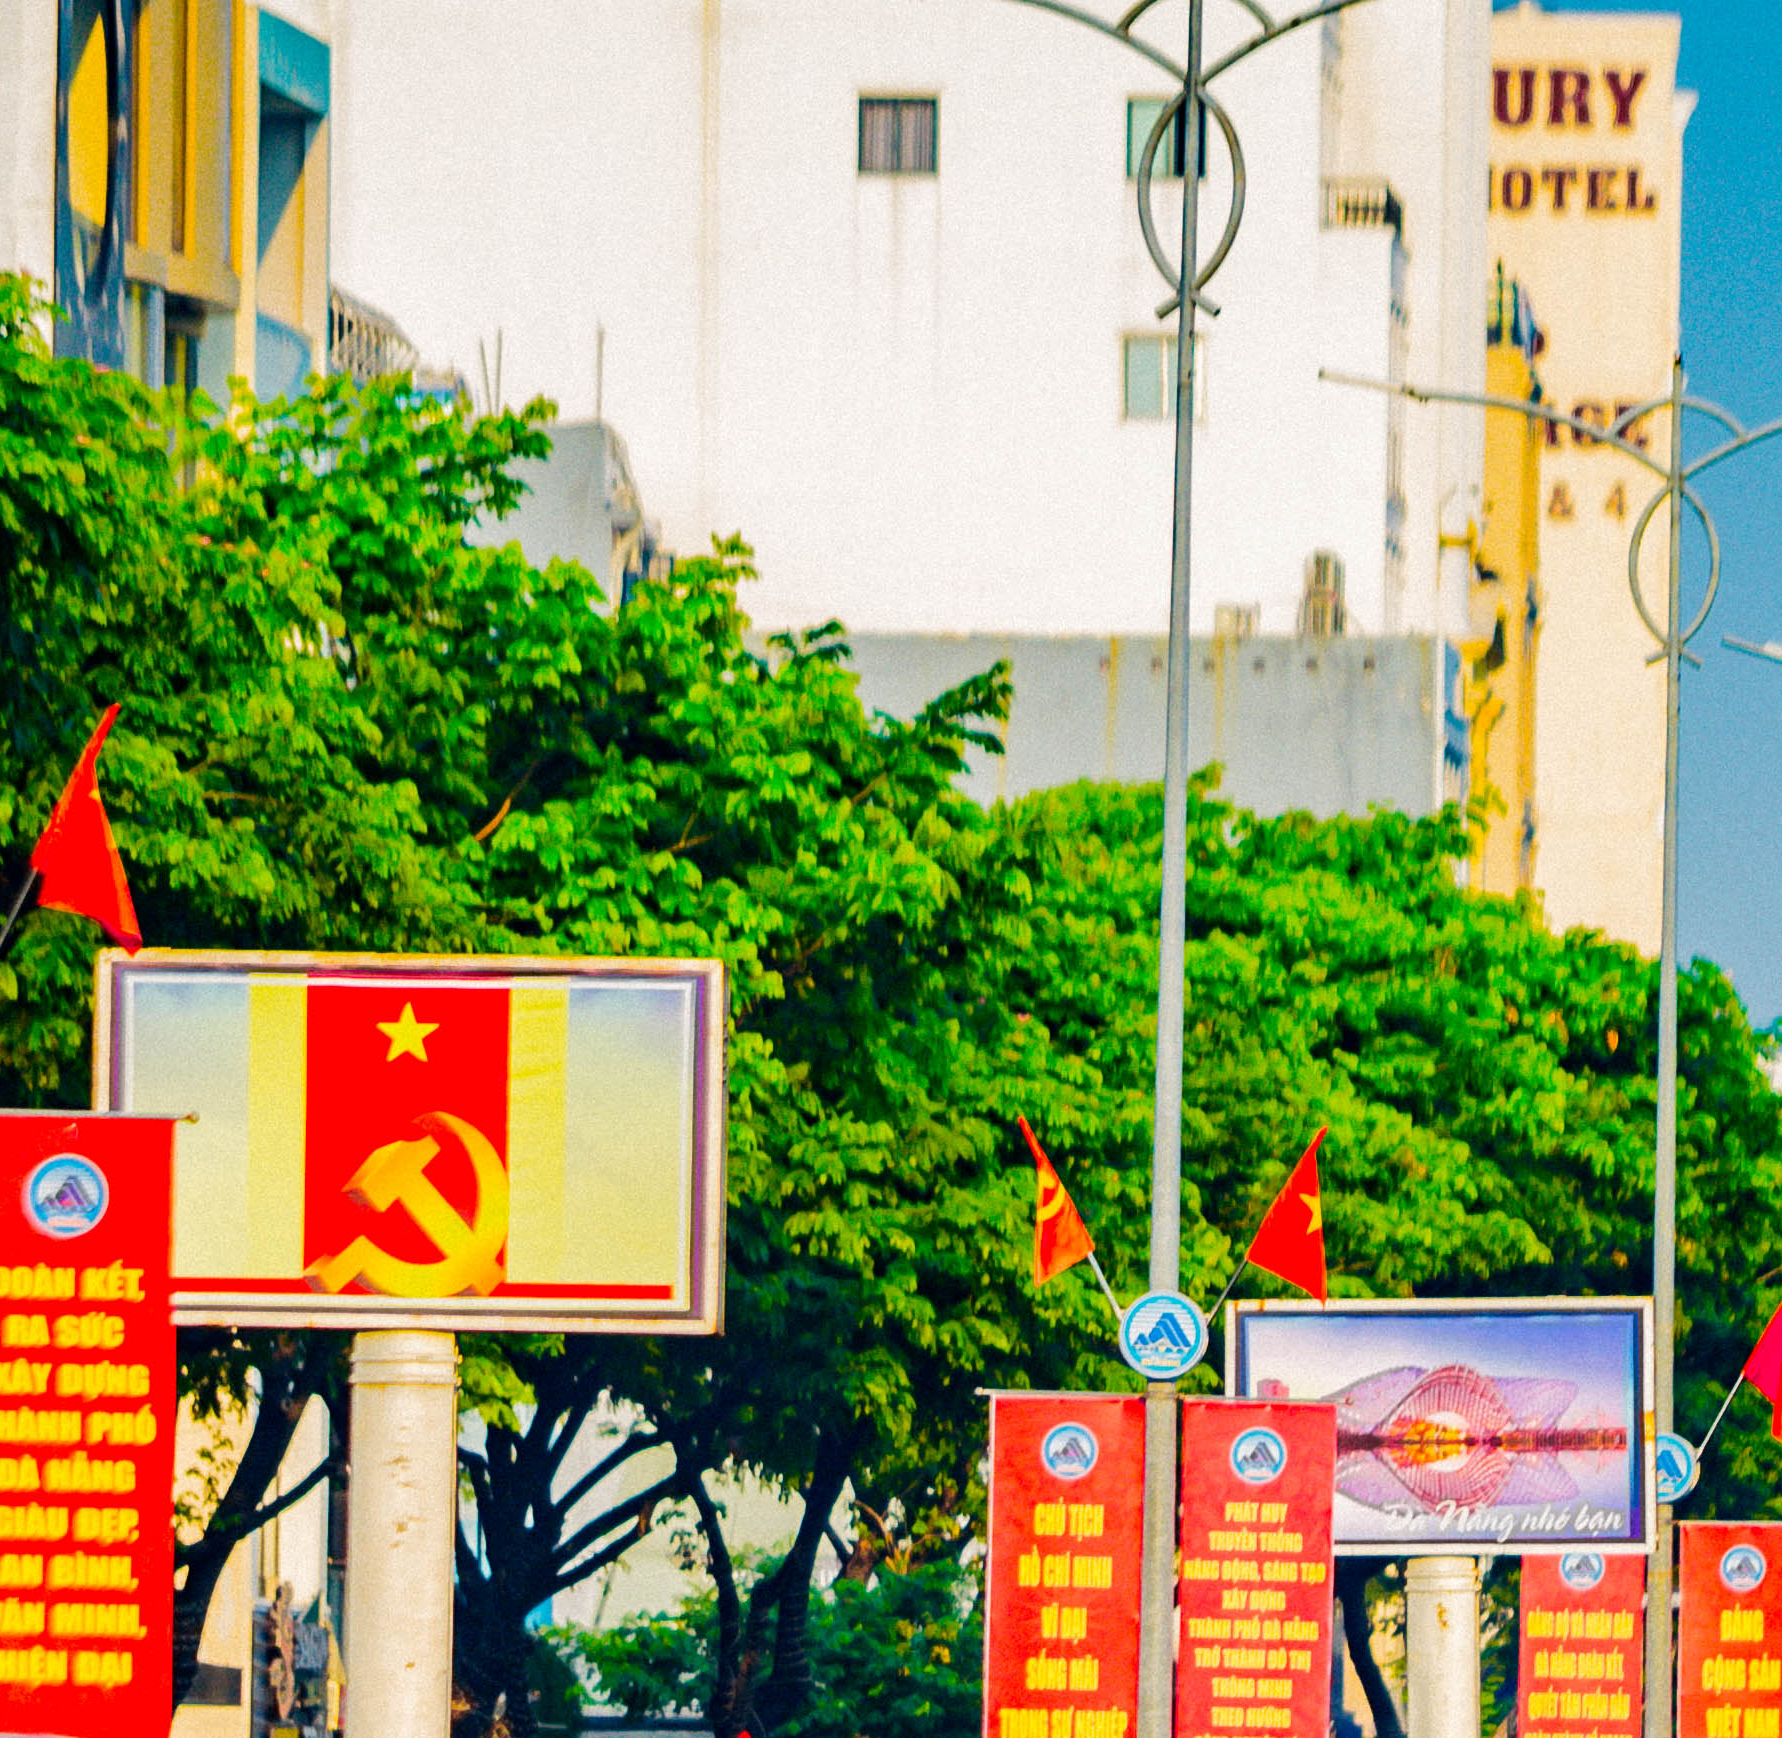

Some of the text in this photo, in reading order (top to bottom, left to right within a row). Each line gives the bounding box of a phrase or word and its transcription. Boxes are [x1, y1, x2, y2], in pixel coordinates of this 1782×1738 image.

[81, 1261, 146, 1301] KẾT,
[2, 1308, 125, 1349] RA SỨC
[56, 1363, 150, 1402] DỰNG
[87, 1408, 157, 1445] PHỐ
[43, 1453, 136, 1493] NẴNG
[1573, 1503, 1623, 1540] bạn
[47, 1550, 139, 1590] BÌNH,
[49, 1597, 147, 1640] MINH,
[72, 1647, 133, 1687] ĐẠI
